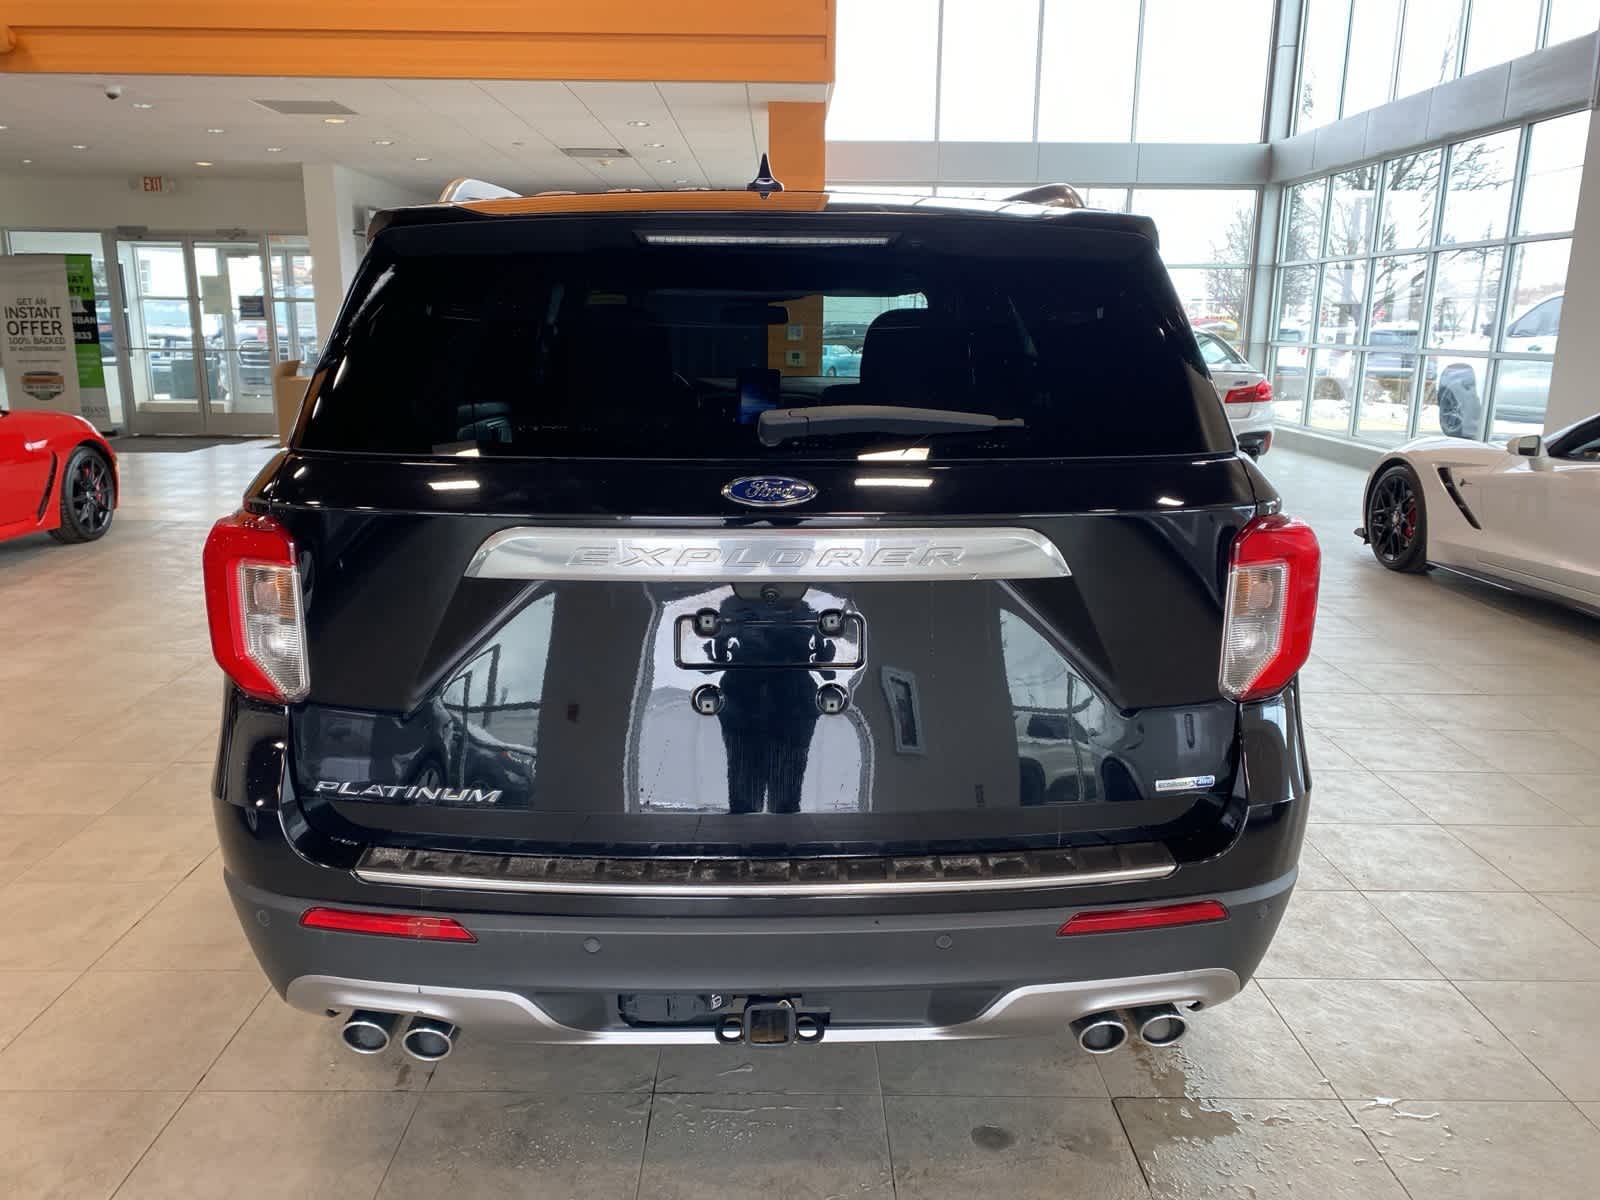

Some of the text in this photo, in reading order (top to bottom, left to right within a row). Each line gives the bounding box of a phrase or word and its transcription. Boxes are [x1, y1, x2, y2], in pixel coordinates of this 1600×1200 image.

[144, 176, 162, 192] EXIT
[17, 297, 47, 306] GET AN
[5, 306, 61, 319] INSTANT
[7, 320, 63, 336] OFFER
[33, 337, 66, 345] BACKED
[744, 480, 797, 499] Ford
[565, 545, 966, 568] EXPLORER
[313, 780, 503, 803] PLATINUM
